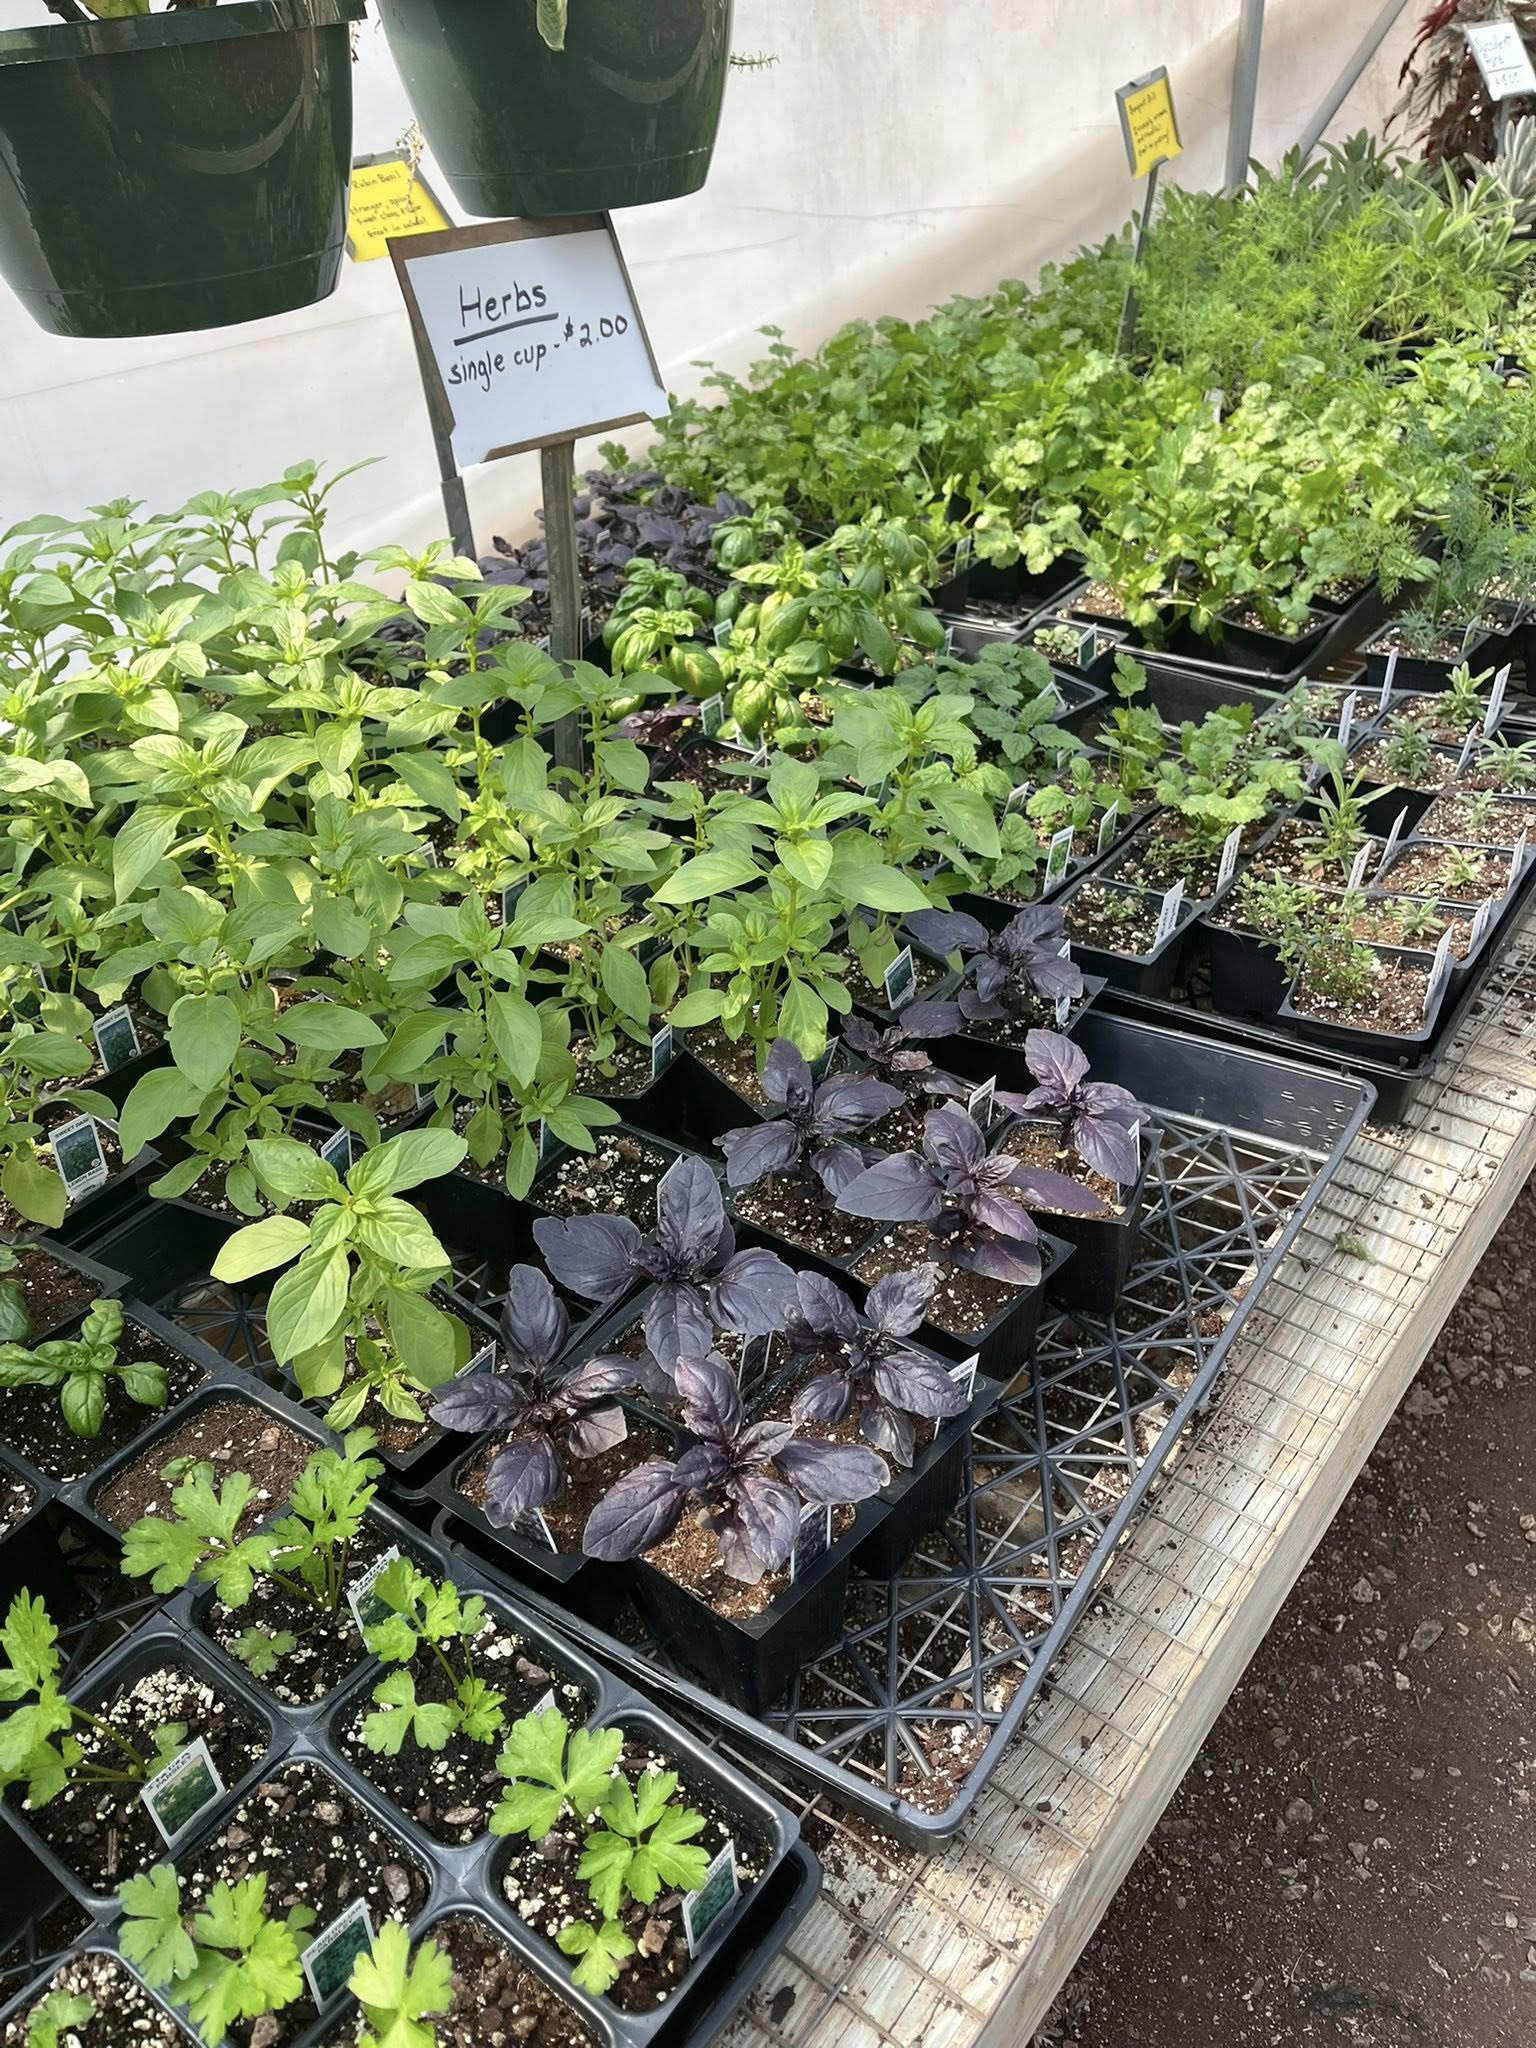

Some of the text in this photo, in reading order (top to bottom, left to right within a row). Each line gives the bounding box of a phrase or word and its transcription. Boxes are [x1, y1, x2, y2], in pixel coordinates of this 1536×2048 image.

[377, 170, 401, 183] Basil
[459, 280, 547, 328] Herbs
[448, 350, 506, 393] single
[514, 343, 547, 371] cup
[563, 315, 628, 348] $2.00
[54, 1125, 75, 1139] SWEET
[68, 1173, 87, 1188] LEMON
